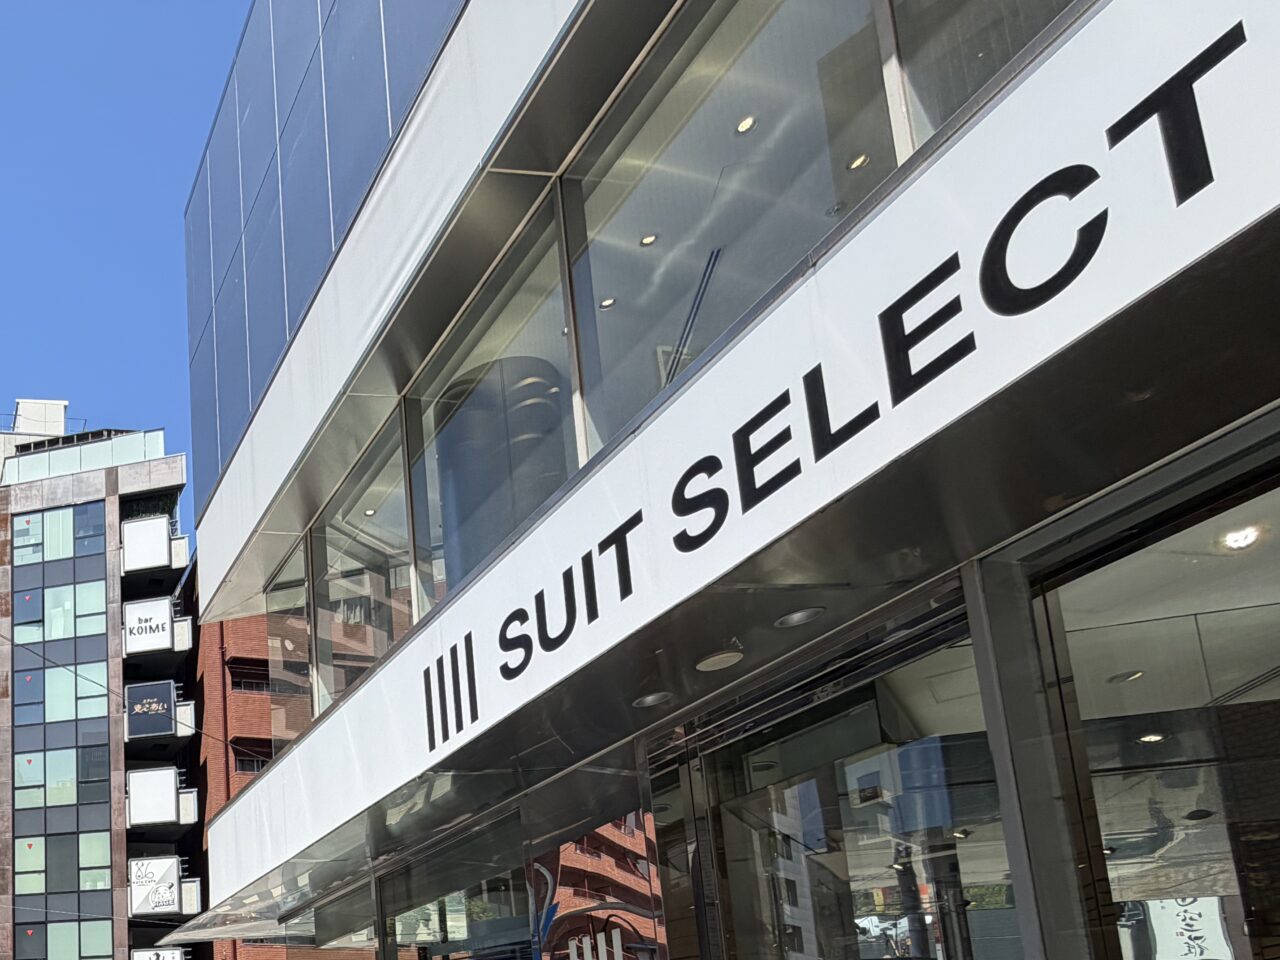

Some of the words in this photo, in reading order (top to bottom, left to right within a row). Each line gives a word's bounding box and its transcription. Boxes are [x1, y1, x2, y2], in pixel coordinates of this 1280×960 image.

[499, 510, 644, 682] SUIT
[671, 19, 1248, 554] SELECT
[138, 616, 153, 624] bar
[128, 622, 167, 636] KOIME
